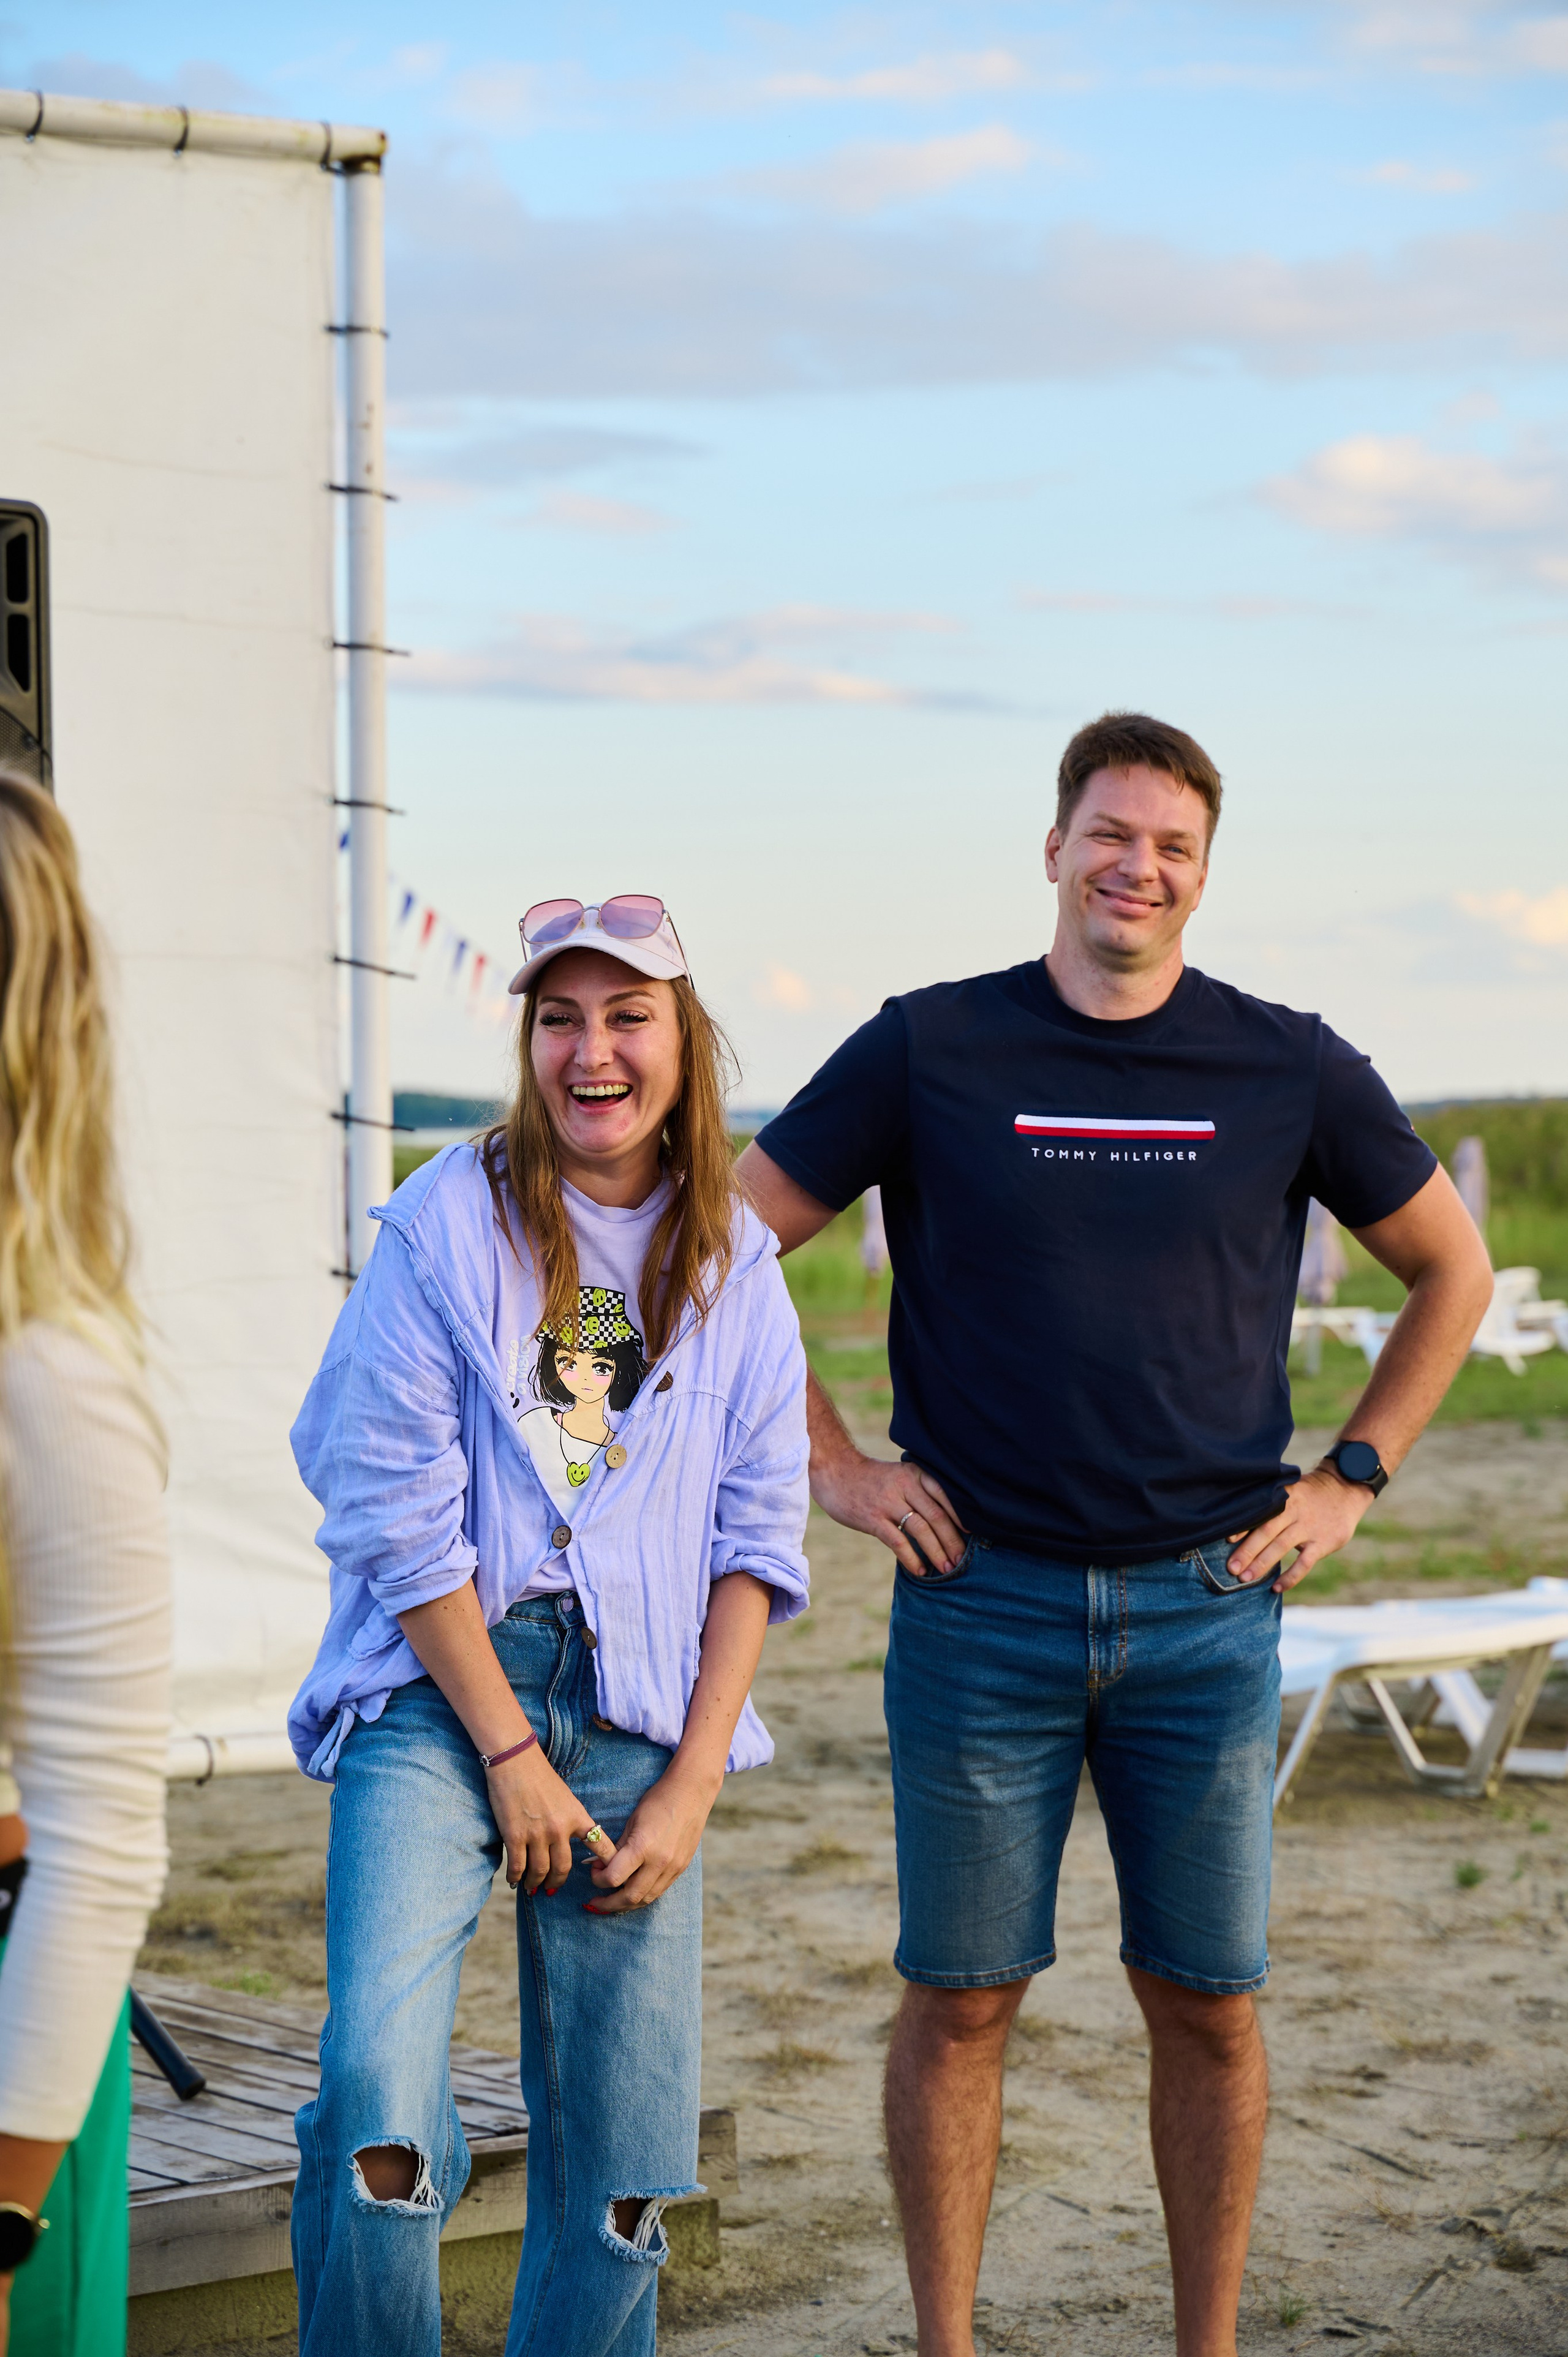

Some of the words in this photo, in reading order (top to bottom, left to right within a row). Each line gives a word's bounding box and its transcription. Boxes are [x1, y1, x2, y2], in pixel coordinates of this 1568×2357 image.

[1031, 1147, 1096, 1161] TOMMY
[1110, 1151, 1197, 1161] HILFIGER
[506, 1339, 519, 1393] create
[517, 1335, 530, 1379] vision
[516, 1382, 526, 1395] a
